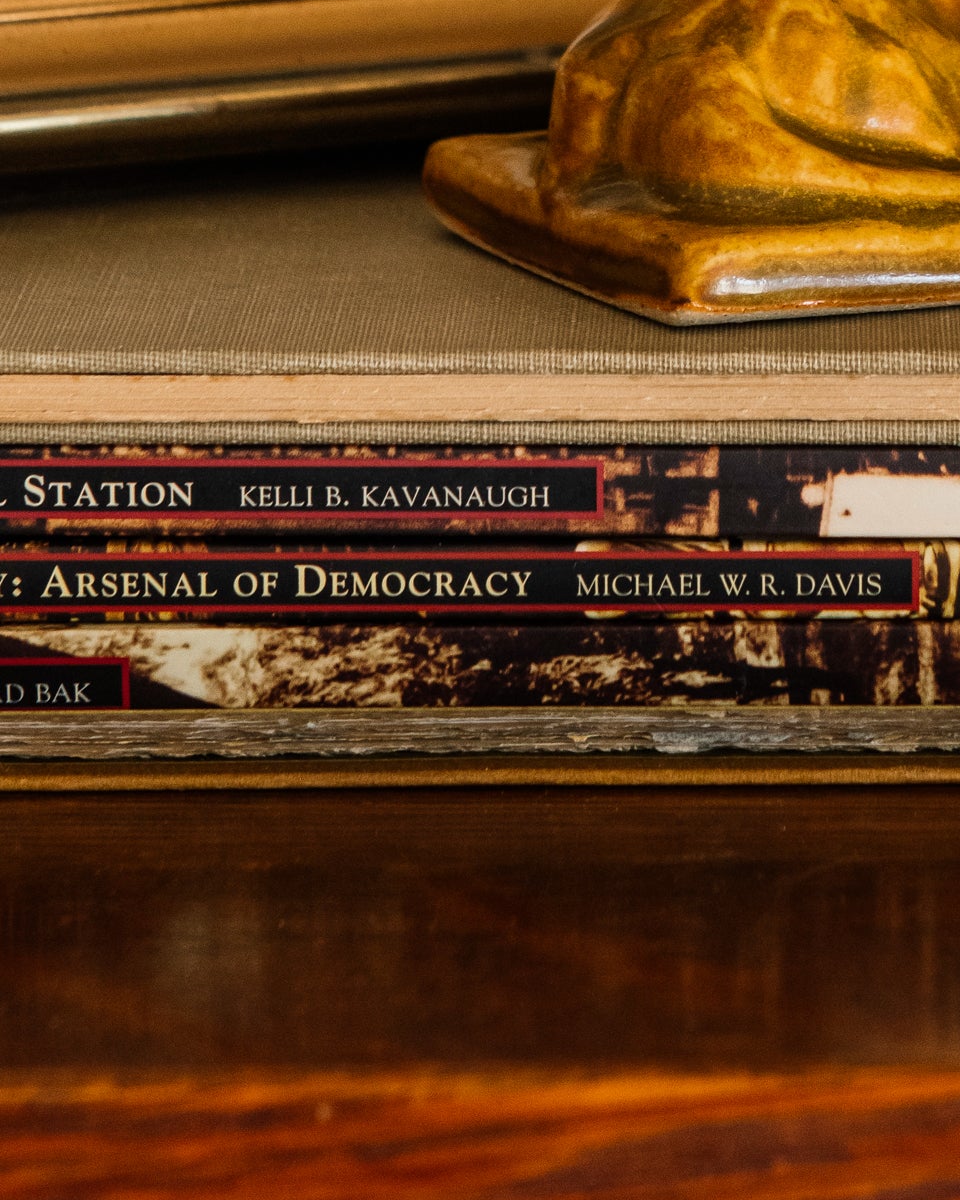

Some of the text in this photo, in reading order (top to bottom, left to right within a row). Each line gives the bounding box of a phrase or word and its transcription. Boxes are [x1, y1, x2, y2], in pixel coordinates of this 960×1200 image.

[23, 474, 550, 508] STATION KELLI B. KAVANAUGH
[40, 565, 218, 598] ARSENAL
[233, 572, 279, 597] OF
[294, 564, 532, 597] DEMOCRACY
[576, 573, 711, 596] MICHAEL
[719, 573, 750, 596] W.
[760, 573, 785, 596] R.
[796, 573, 882, 596] DAVIS
[0, 682, 91, 704] D BAK
